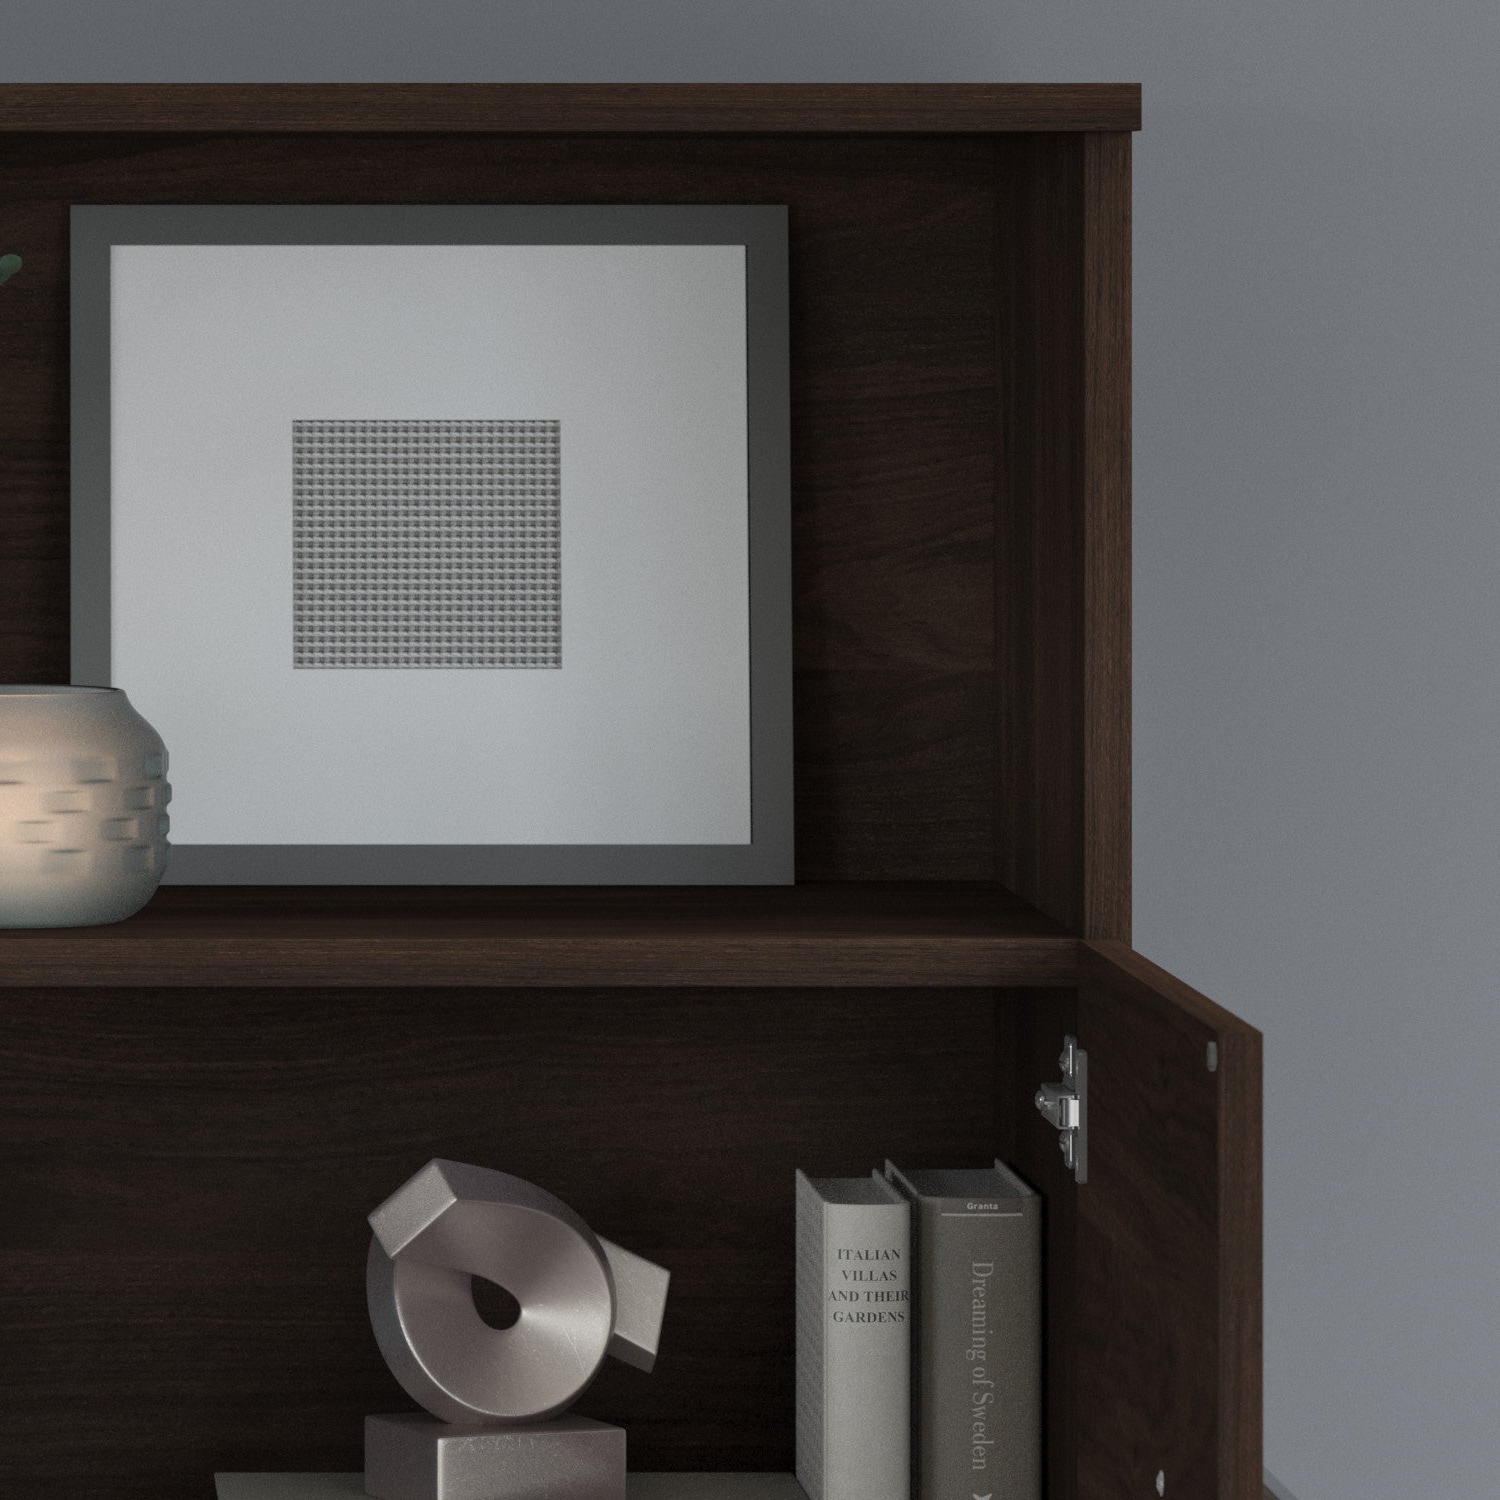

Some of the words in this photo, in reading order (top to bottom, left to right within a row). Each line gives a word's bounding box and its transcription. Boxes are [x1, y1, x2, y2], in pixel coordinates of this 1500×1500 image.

[966, 1202, 999, 1210] Granta
[837, 1249, 901, 1261] ITALIAN
[842, 1270, 897, 1282] VILLAS
[828, 1291, 859, 1302] AND
[864, 1290, 910, 1302] THEIR
[833, 1312, 905, 1323] GARDENS
[966, 1262, 994, 1361] Dreaming
[971, 1367, 994, 1387] of
[971, 1392, 995, 1470] Sweden
